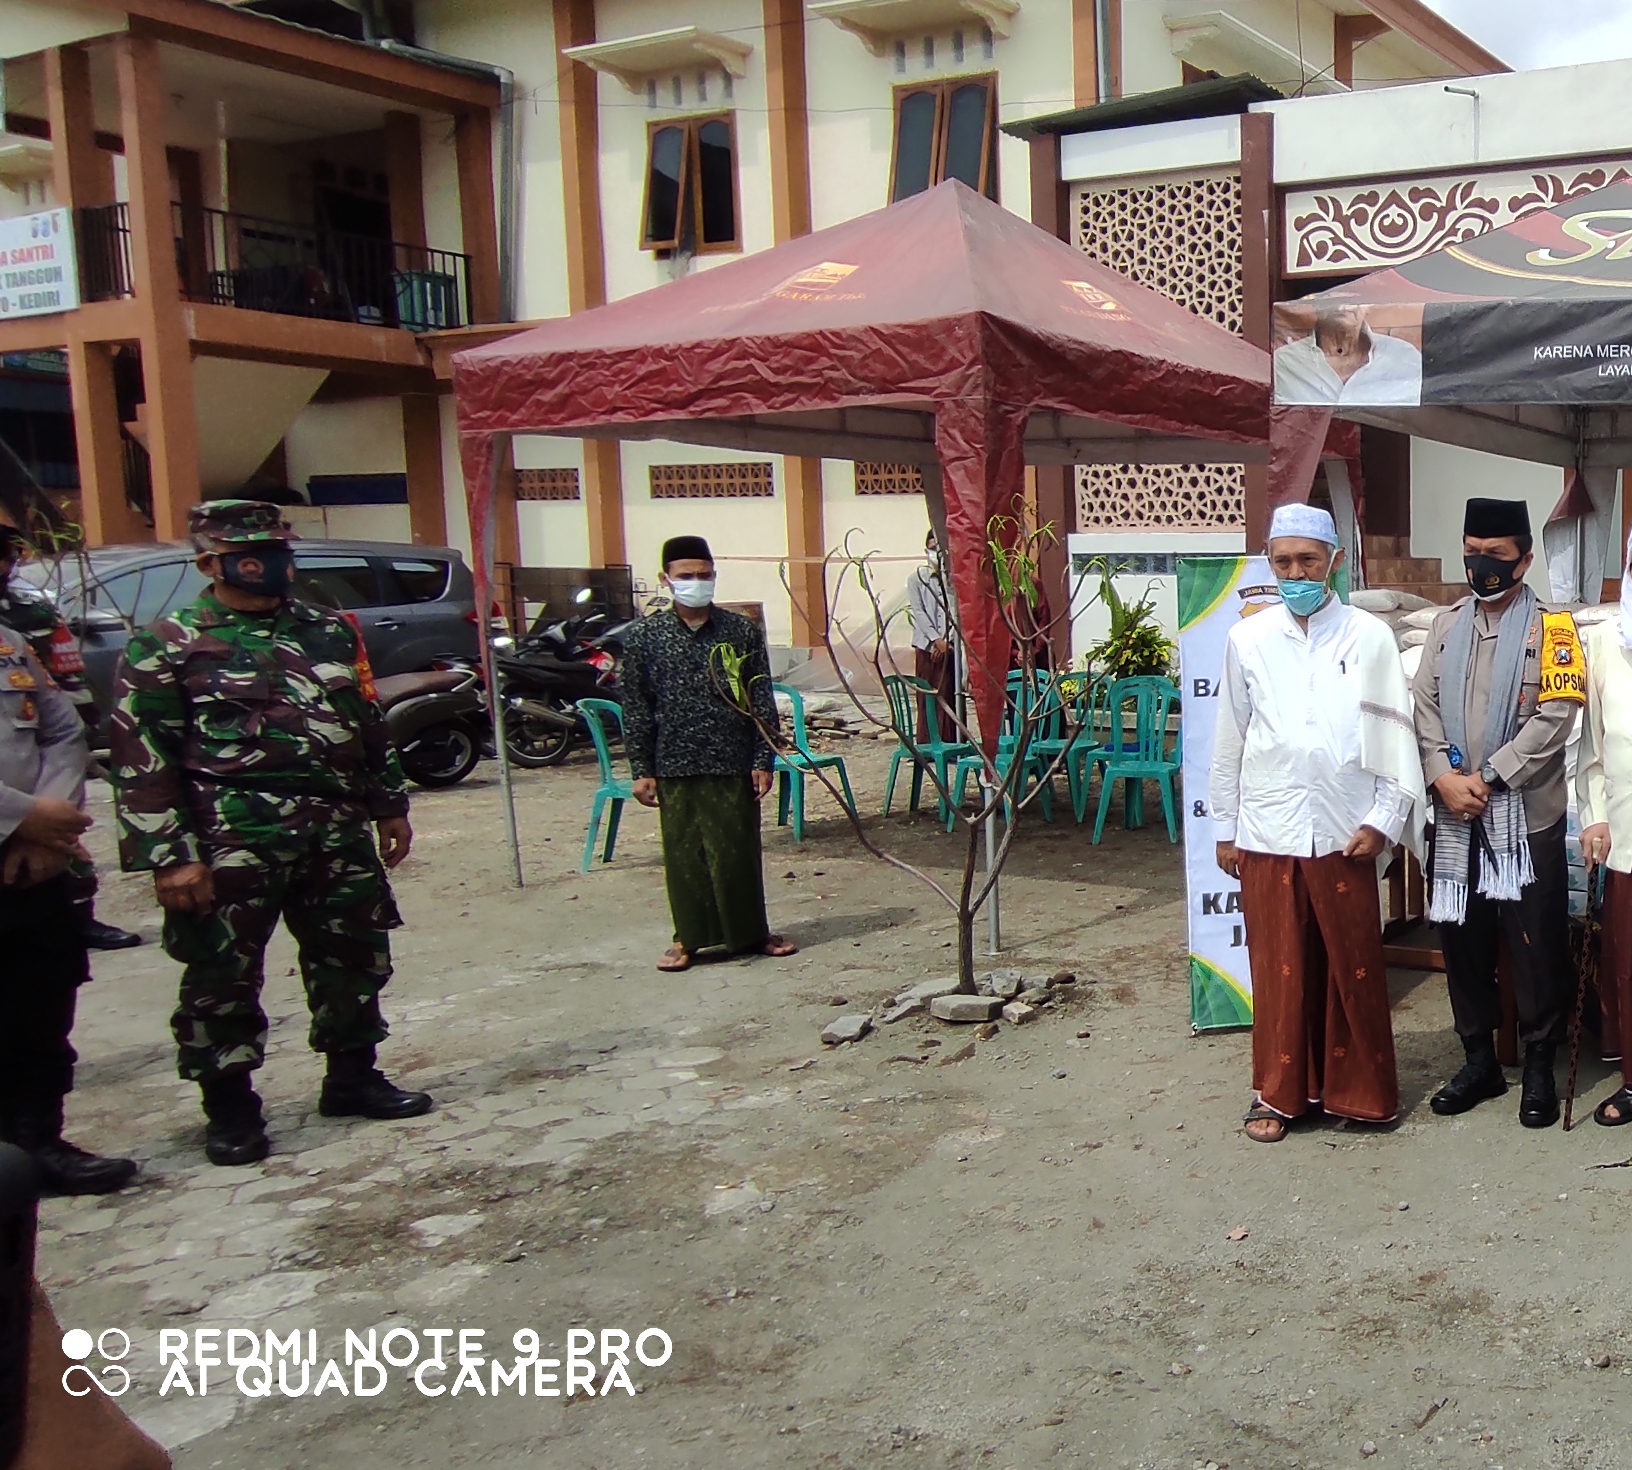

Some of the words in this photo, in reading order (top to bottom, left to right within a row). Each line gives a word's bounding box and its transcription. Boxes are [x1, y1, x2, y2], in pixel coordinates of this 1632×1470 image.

[10, 243, 55, 265] SANTRI
[4, 266, 63, 289] TANGGUH
[18, 290, 61, 310] KEDIRI
[1533, 344, 1594, 361] KARENA
[1192, 799, 1209, 819] &
